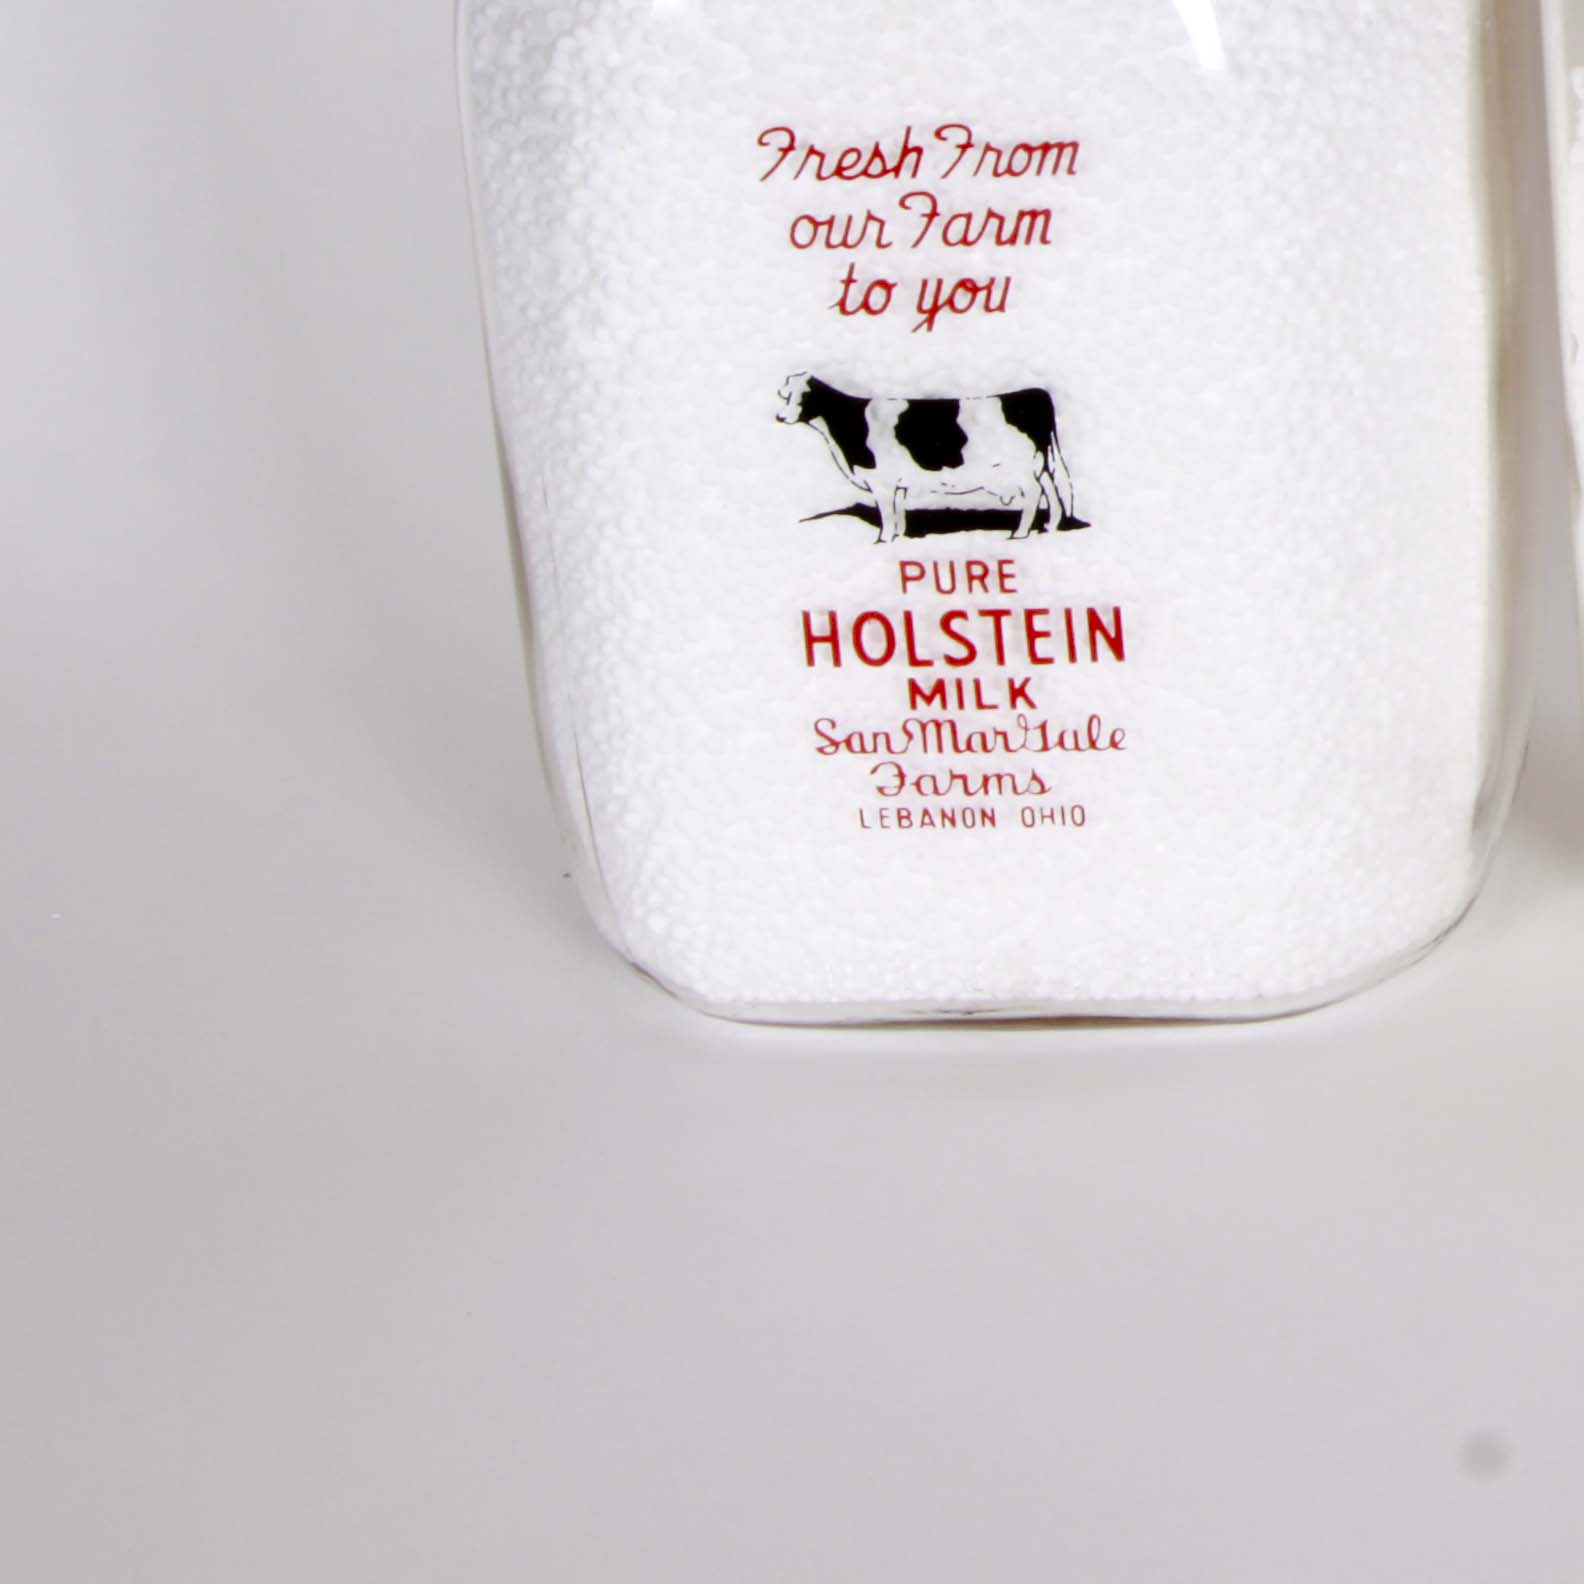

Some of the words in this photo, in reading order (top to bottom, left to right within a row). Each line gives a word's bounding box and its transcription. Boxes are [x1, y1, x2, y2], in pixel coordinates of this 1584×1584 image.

[757, 125, 924, 183] Fresh
[932, 123, 1081, 178] From
[789, 211, 892, 251] our
[898, 190, 1053, 249] Farm
[834, 263, 897, 317] to
[914, 274, 1012, 333] you
[899, 558, 1019, 596] PURE
[801, 606, 1126, 669] HOLSTEIN
[907, 675, 1038, 711] MILK
[869, 761, 1053, 798] Farms
[858, 806, 997, 829] LEBANON
[1020, 804, 1086, 829] OHIO
